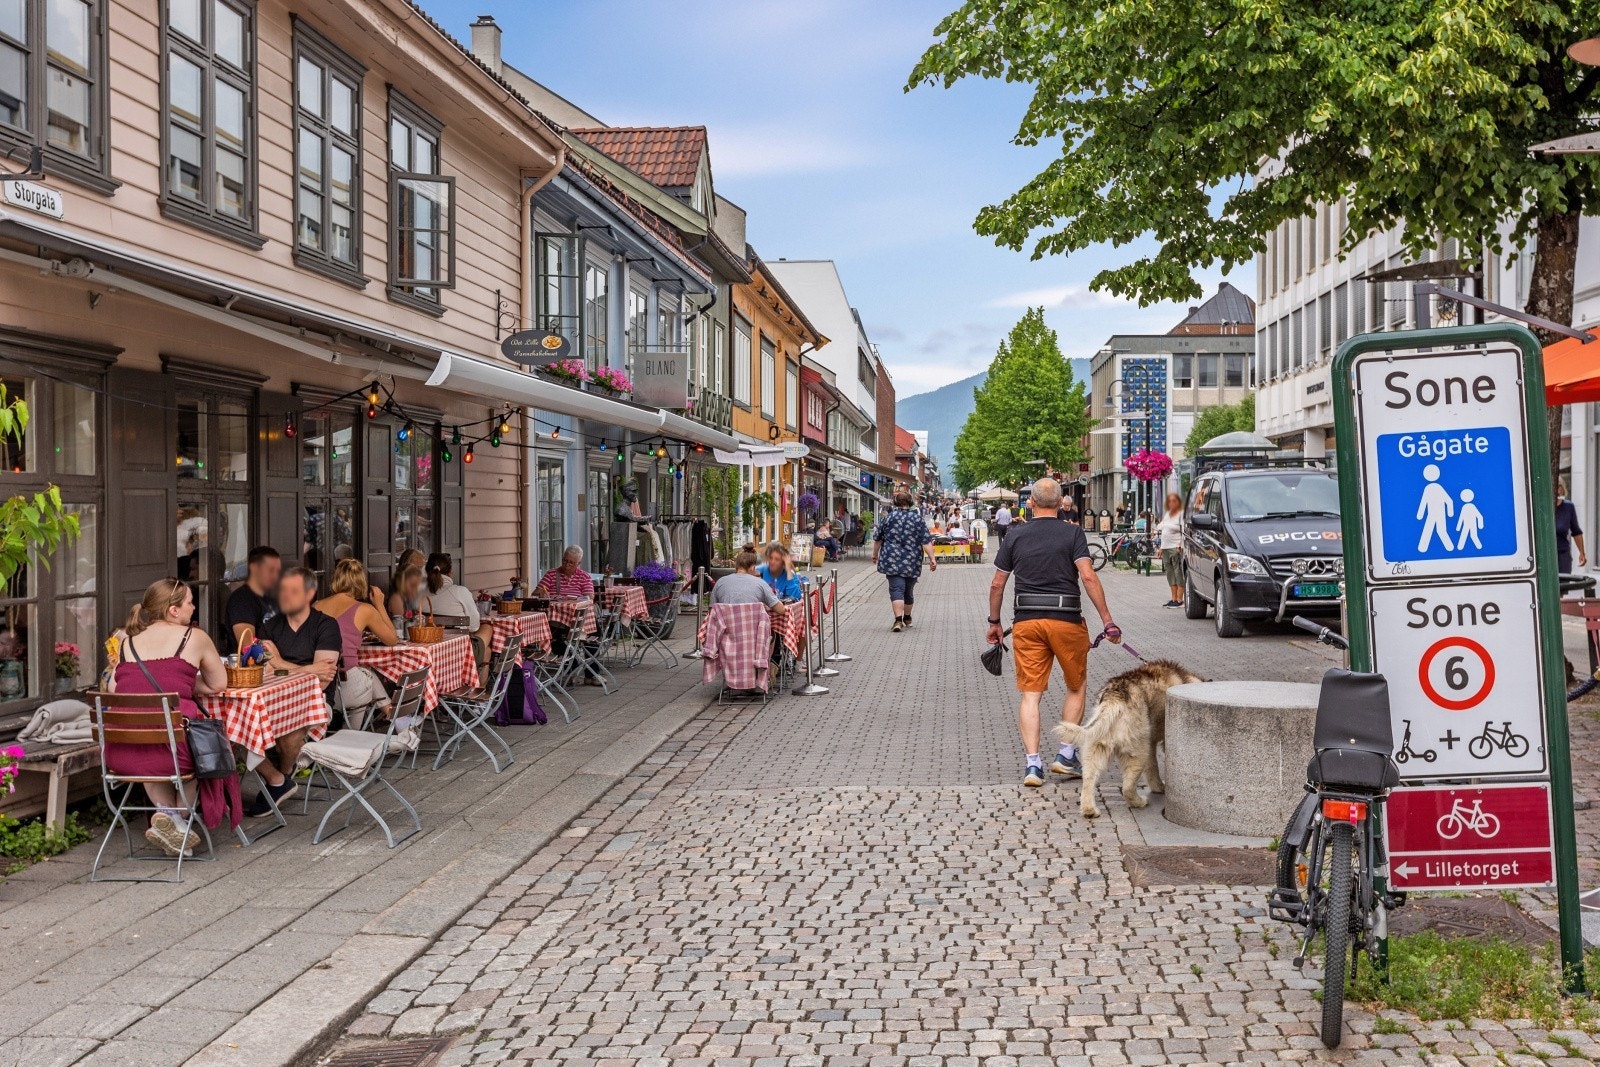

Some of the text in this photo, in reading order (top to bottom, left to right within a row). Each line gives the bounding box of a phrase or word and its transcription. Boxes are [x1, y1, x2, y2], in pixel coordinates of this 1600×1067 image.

[14, 181, 56, 211] Storgata
[645, 360, 676, 376] BLANC
[1384, 370, 1496, 410] Sone
[1398, 432, 1489, 461] Gågate
[1258, 531, 1343, 545] BYGGØ
[1301, 585, 1312, 594] HS
[1406, 597, 1501, 629] Sone
[1444, 655, 1469, 691] 6
[1425, 860, 1519, 880] Lilletorget
